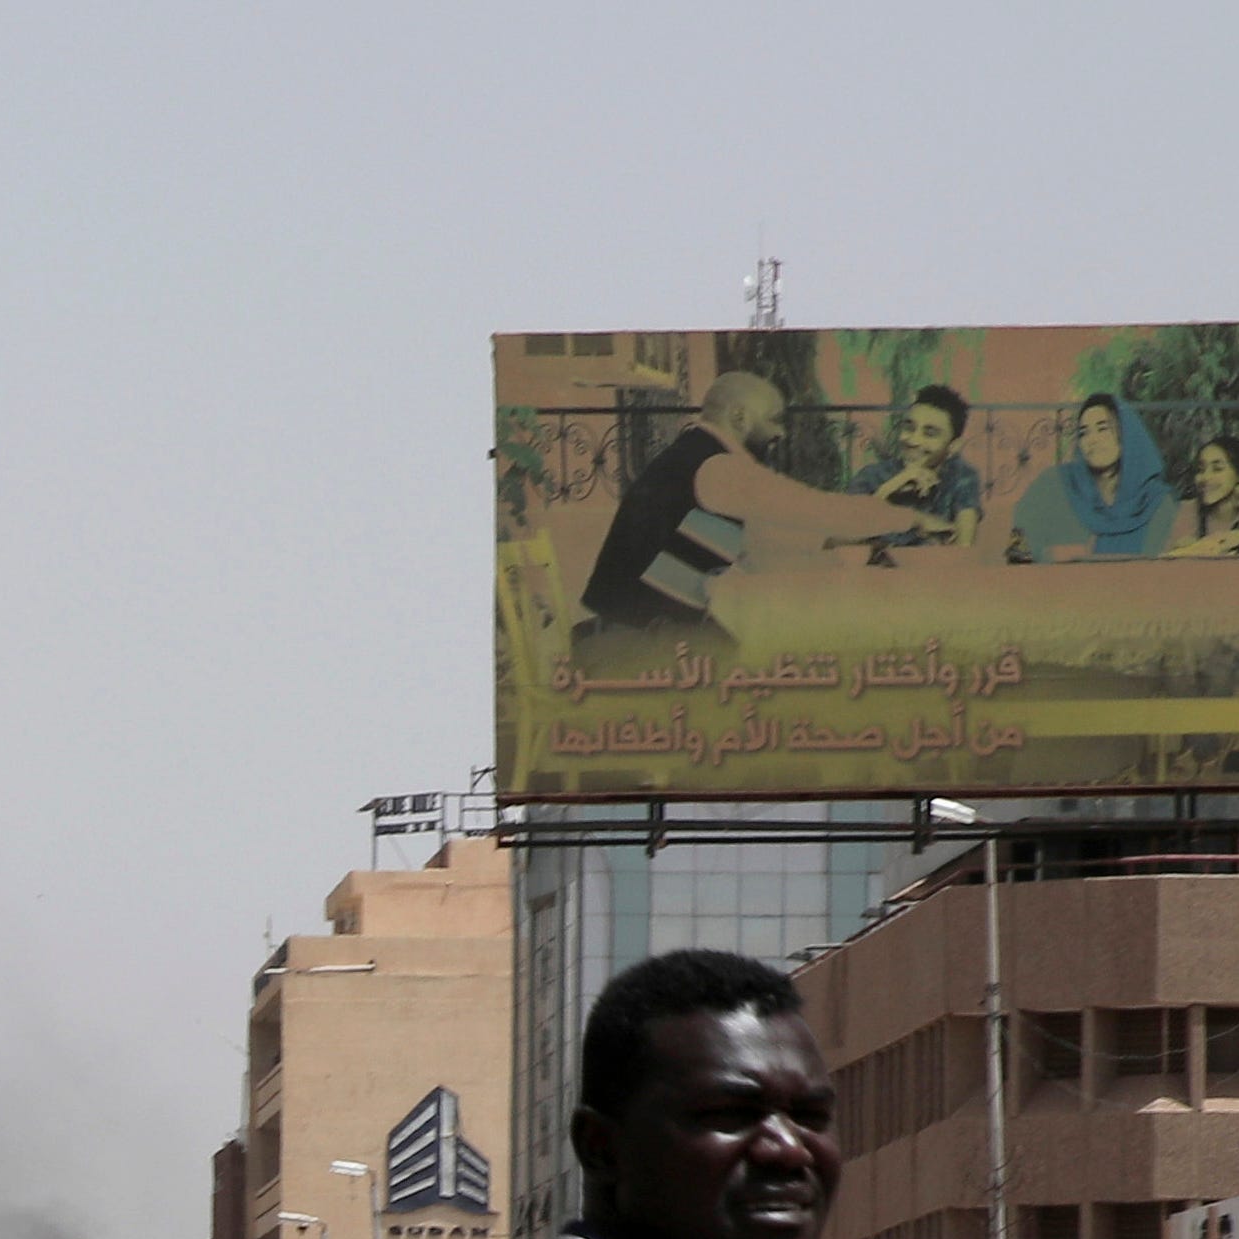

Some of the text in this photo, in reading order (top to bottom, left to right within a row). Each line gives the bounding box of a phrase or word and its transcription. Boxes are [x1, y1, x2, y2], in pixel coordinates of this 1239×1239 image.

[719, 649, 839, 704] تنظيم
[966, 644, 1024, 697] قرر
[551, 700, 1025, 766] من أجل صحة الأم وأطفالها
